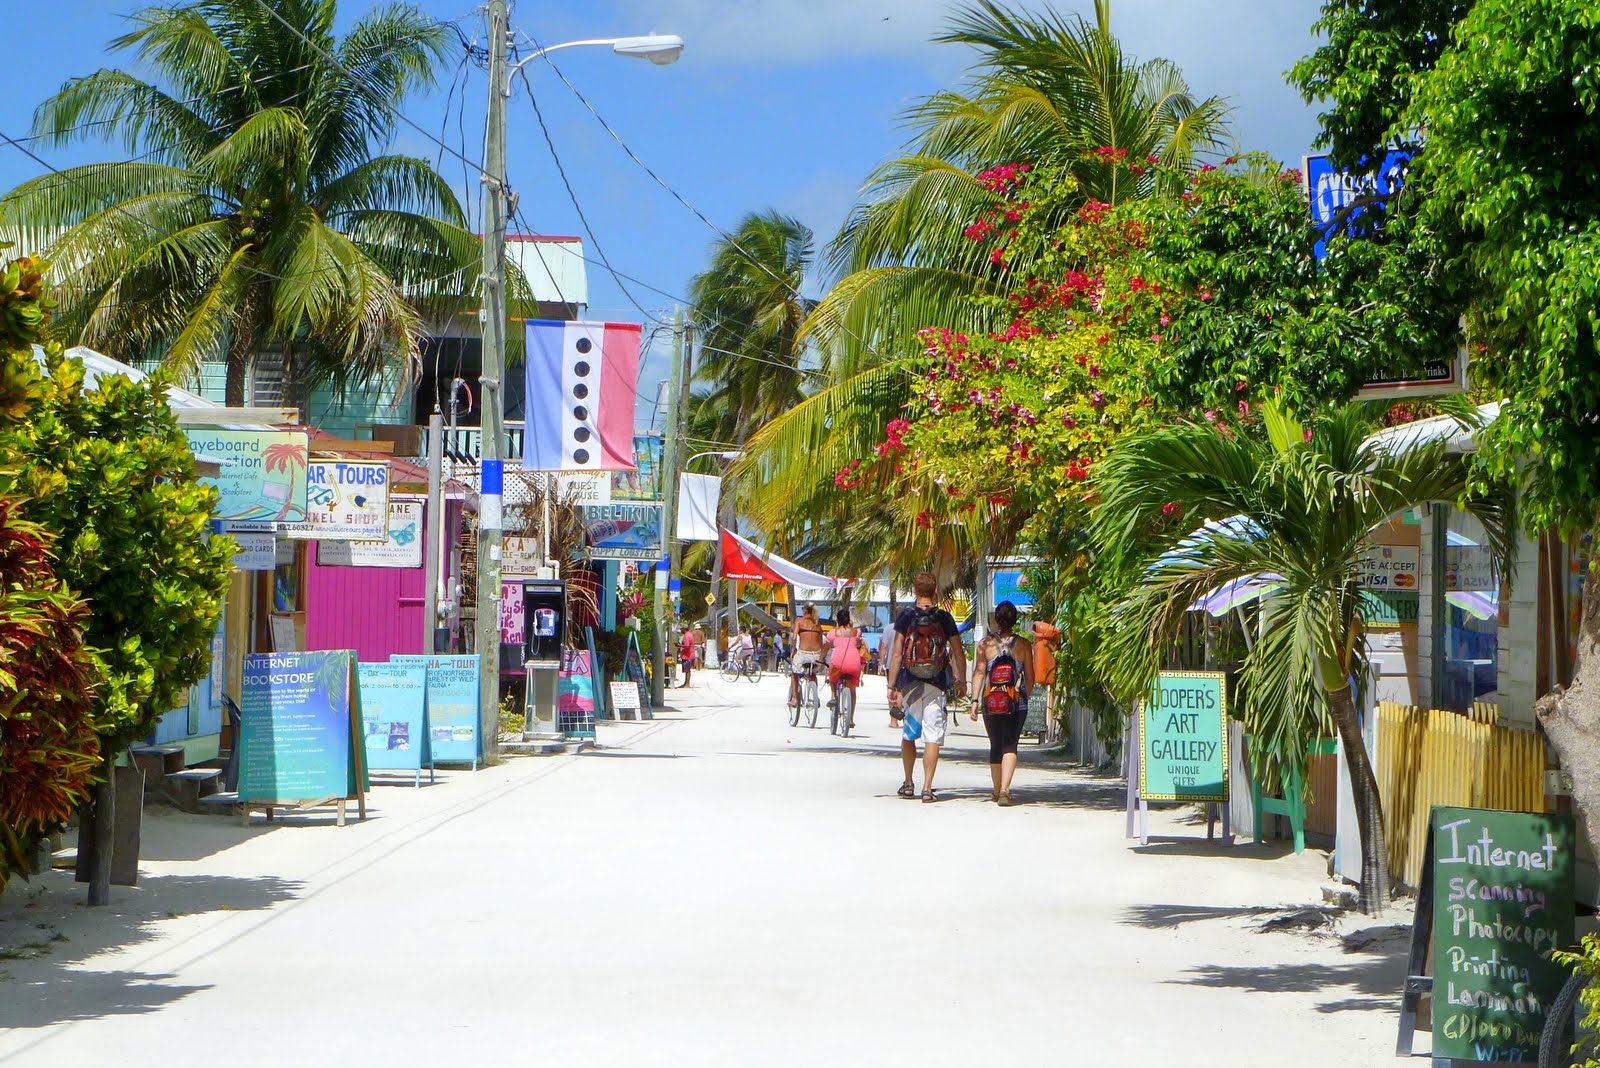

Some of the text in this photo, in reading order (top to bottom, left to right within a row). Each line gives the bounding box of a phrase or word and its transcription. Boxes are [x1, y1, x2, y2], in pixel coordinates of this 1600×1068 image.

[1424, 366, 1447, 377] rinks
[336, 464, 386, 485] TOURS
[346, 513, 379, 525] SHOP
[588, 505, 663, 522] BELIKIN
[619, 549, 656, 558] LOBSTER
[1378, 562, 1415, 571] ACCEPT
[1362, 575, 1388, 585] VISA
[243, 658, 300, 670] INTERNET
[243, 672, 314, 686] BOOKSTORE
[1165, 713, 1199, 734] ART
[1151, 739, 1217, 762] GALLERY
[1168, 765, 1200, 775] UNIQUE
[1173, 777, 1196, 786] GIFTS
[1439, 818, 1558, 871] Internet
